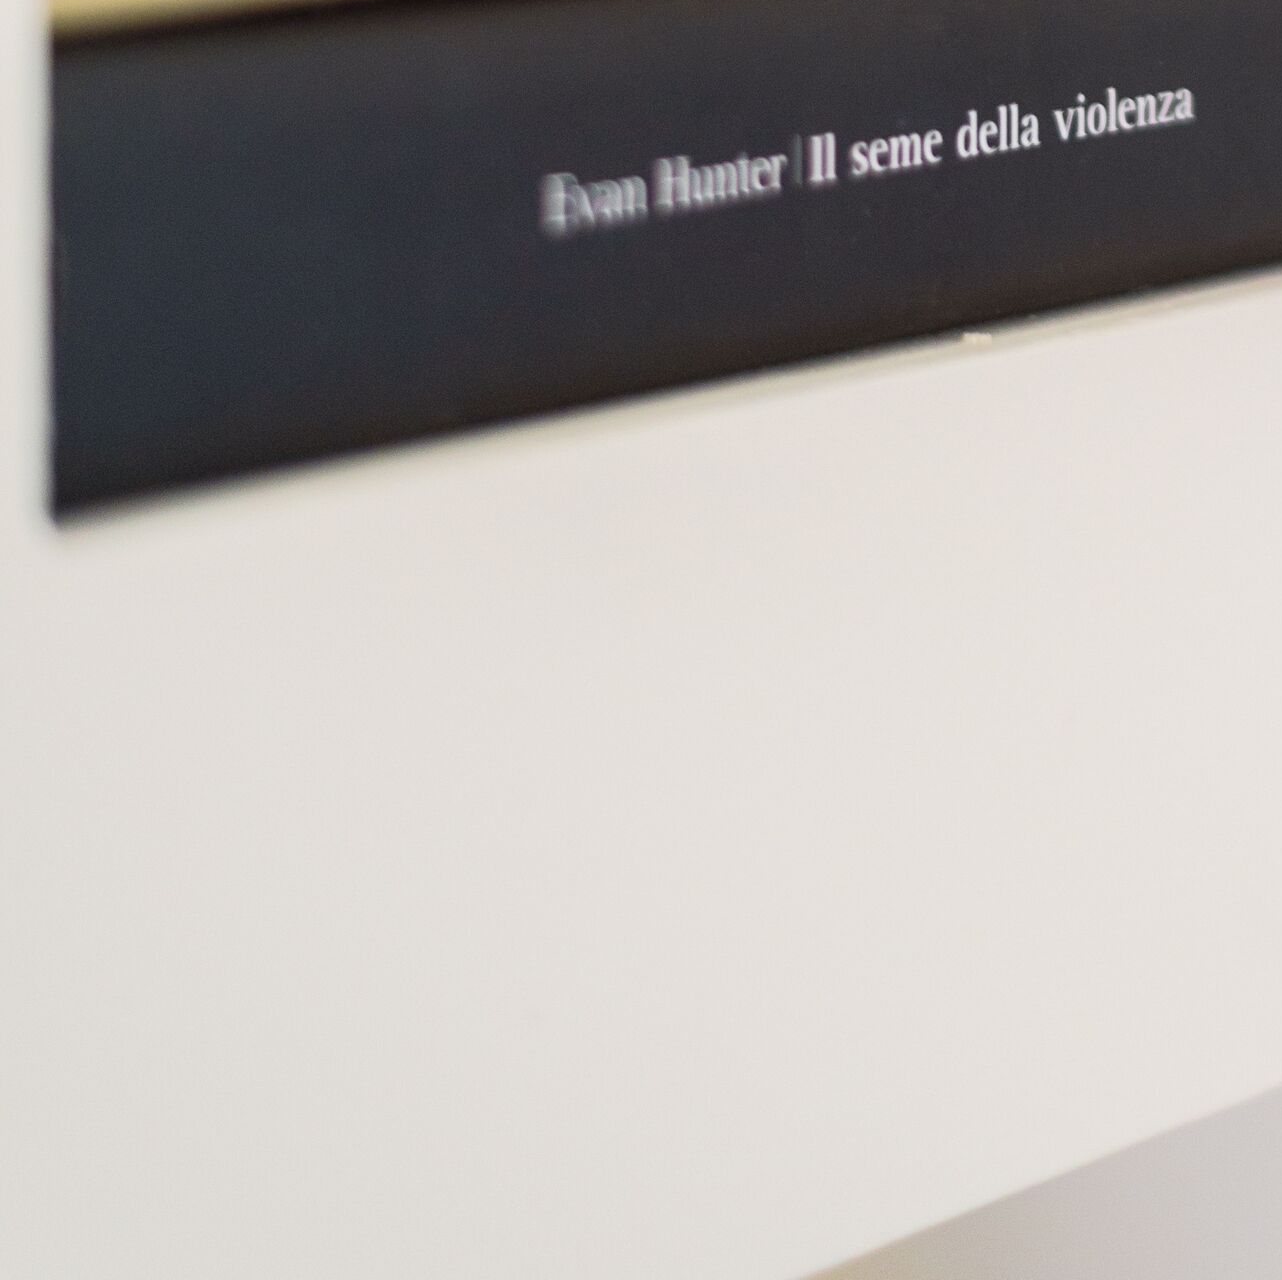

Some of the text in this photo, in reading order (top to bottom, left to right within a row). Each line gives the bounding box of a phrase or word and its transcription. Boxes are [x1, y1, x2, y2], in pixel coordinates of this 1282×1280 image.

[539, 86, 1196, 237] Evan Hunter Il seme della violenza
